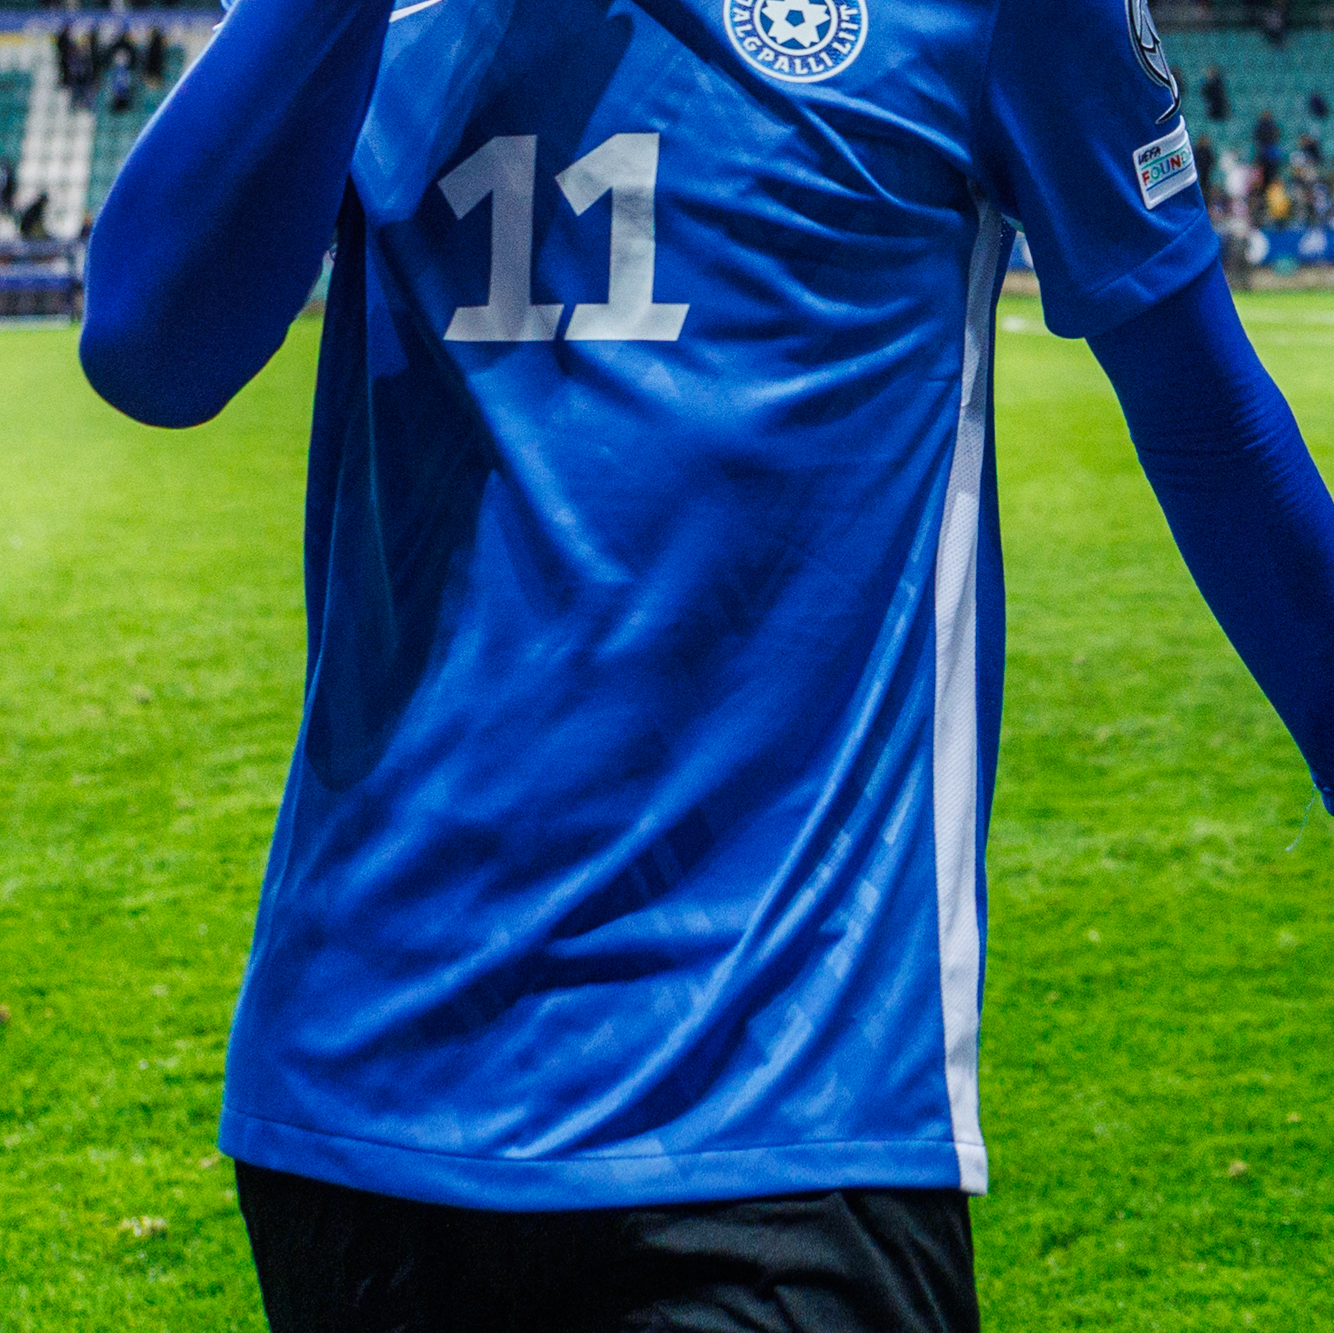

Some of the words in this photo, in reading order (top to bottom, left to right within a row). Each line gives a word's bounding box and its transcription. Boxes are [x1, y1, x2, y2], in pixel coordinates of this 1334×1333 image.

[832, 5, 859, 54] LIIT
[1138, 146, 1161, 165] UEFA
[1142, 148, 1191, 186] FOUND
[437, 132, 690, 342] 11
